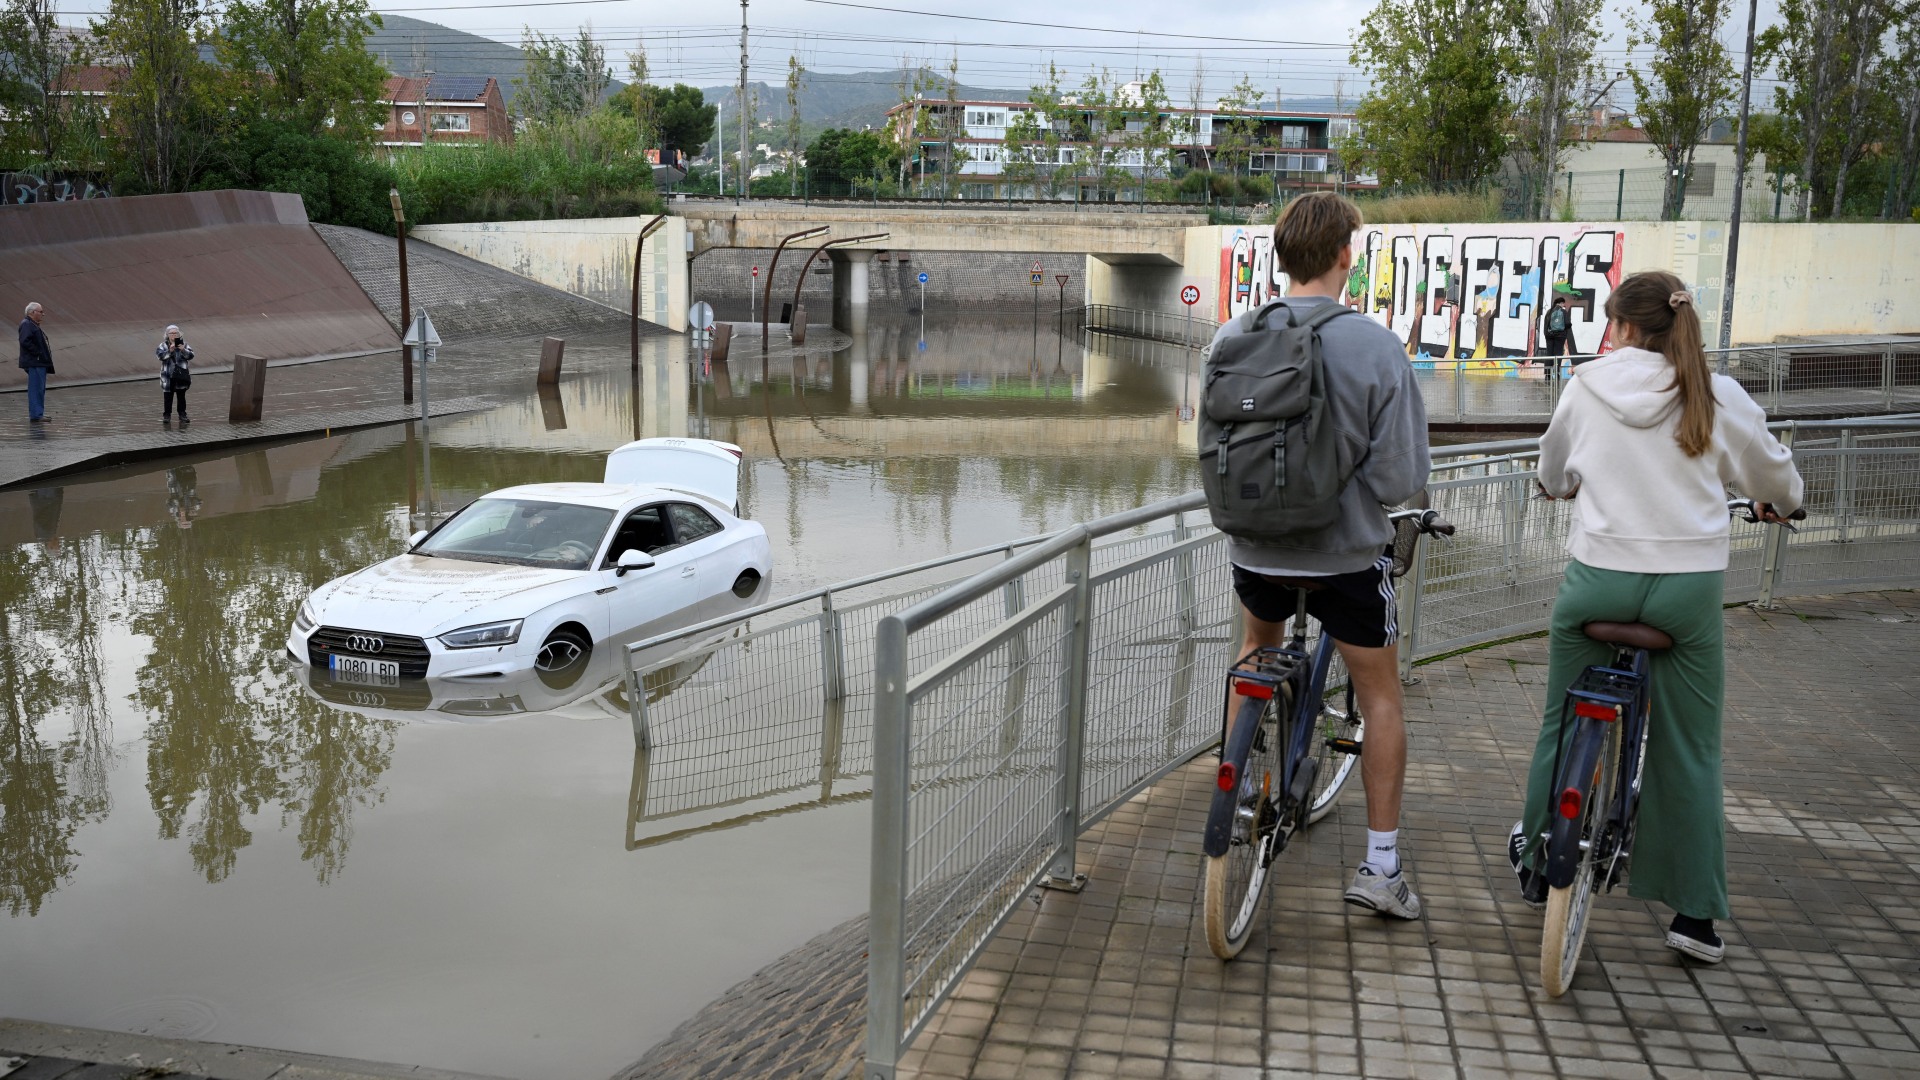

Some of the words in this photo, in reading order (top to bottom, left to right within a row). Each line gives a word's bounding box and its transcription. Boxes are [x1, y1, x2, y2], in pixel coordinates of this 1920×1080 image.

[1709, 243, 1722, 253] 150
[1706, 277, 1720, 287] 100
[1706, 310, 1717, 320] 50
[338, 658, 367, 673] 1080
